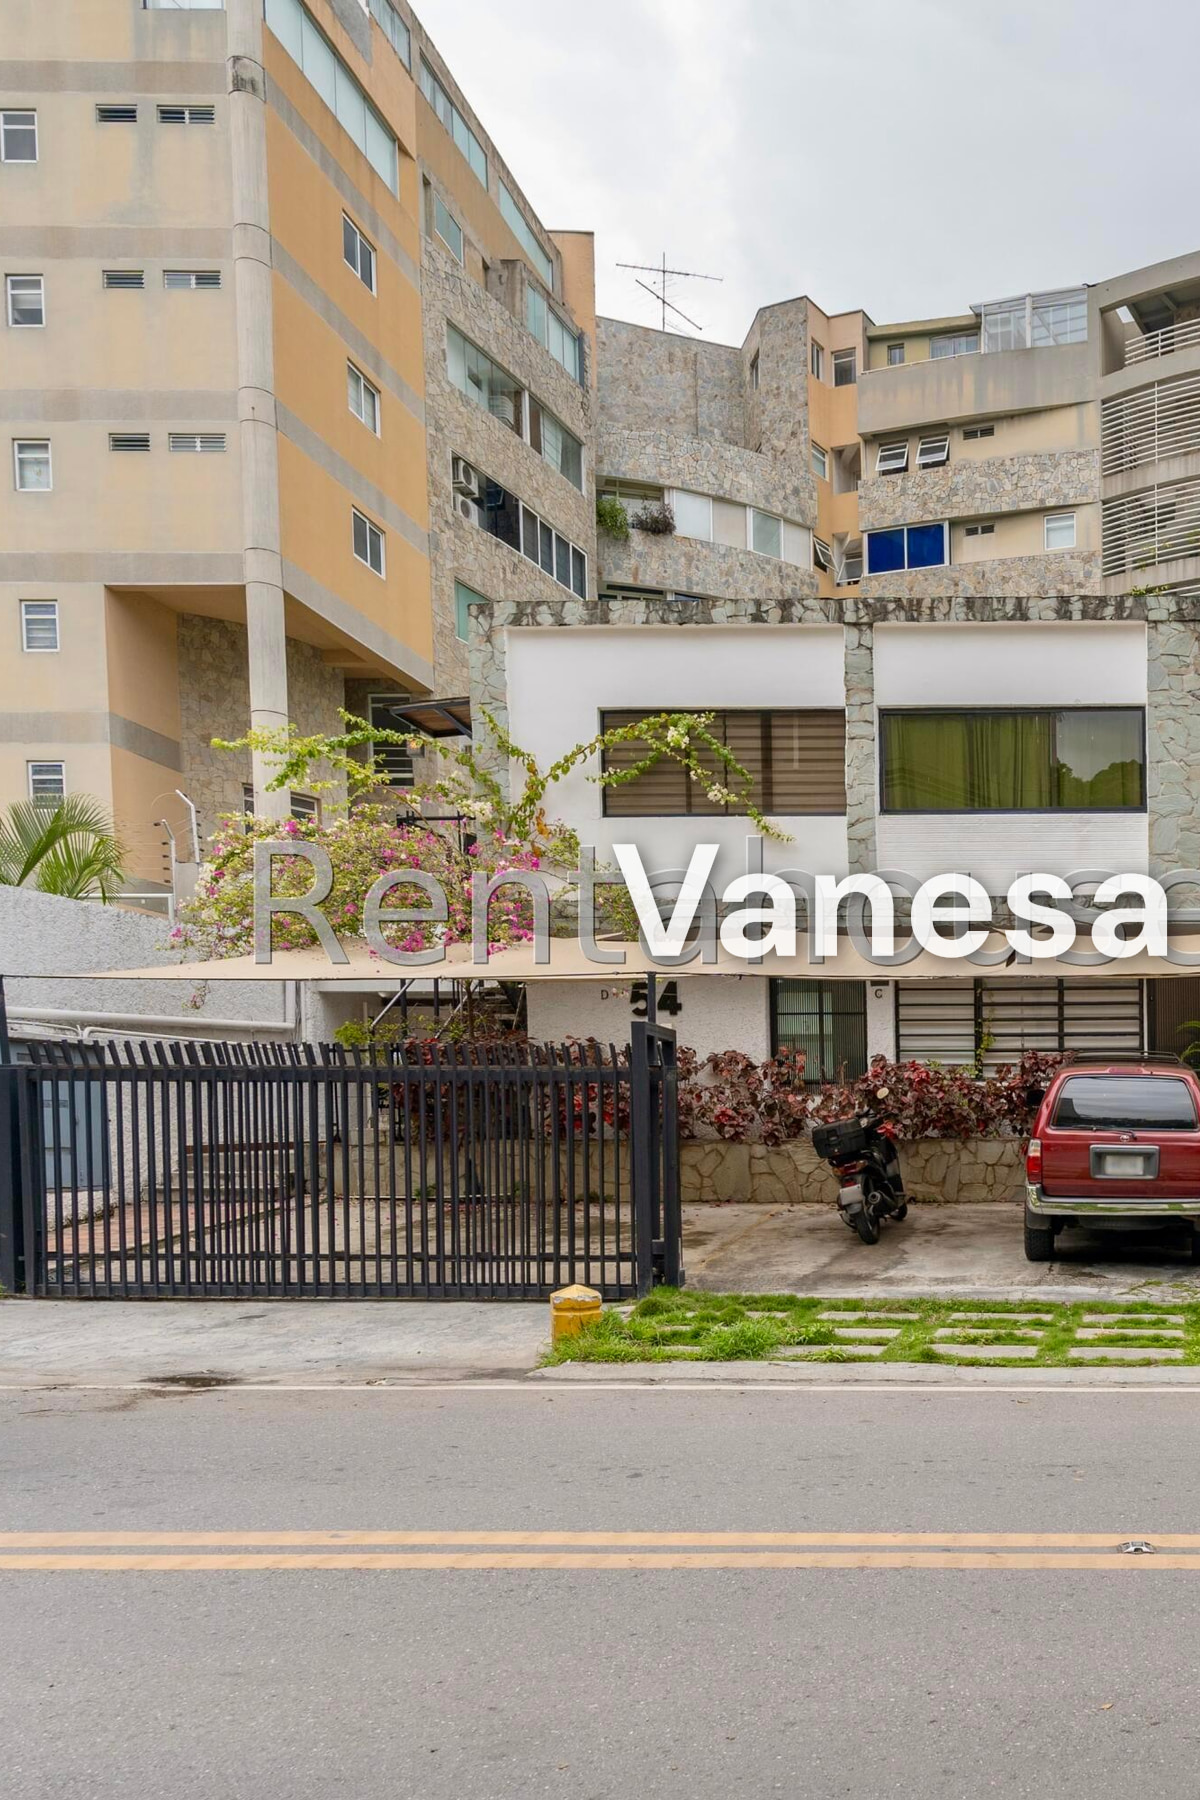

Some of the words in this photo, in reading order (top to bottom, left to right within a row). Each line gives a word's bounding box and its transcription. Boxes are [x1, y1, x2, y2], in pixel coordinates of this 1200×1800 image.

[601, 989, 609, 1000] D
[630, 981, 682, 1017] 54
[874, 988, 883, 999] C
